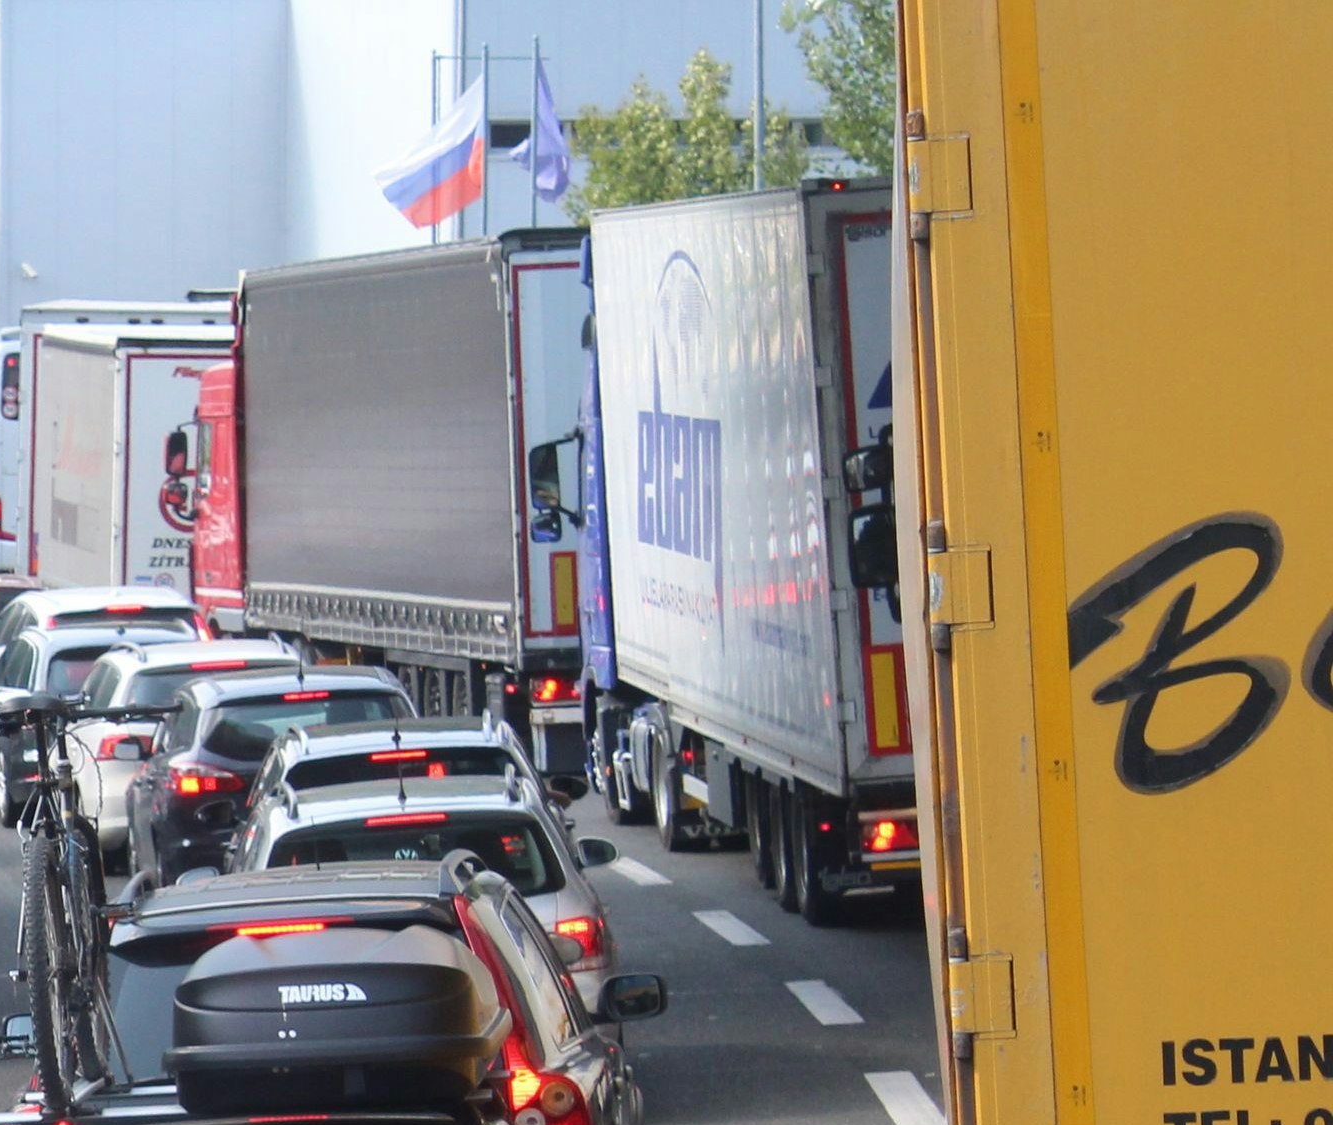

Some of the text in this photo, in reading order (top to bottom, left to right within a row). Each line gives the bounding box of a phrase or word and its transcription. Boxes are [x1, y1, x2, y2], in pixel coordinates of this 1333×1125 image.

[149, 554, 191, 568] ZÍTR
[278, 983, 346, 1003] TAURUS
[1162, 1034, 1333, 1086] ISTAN
